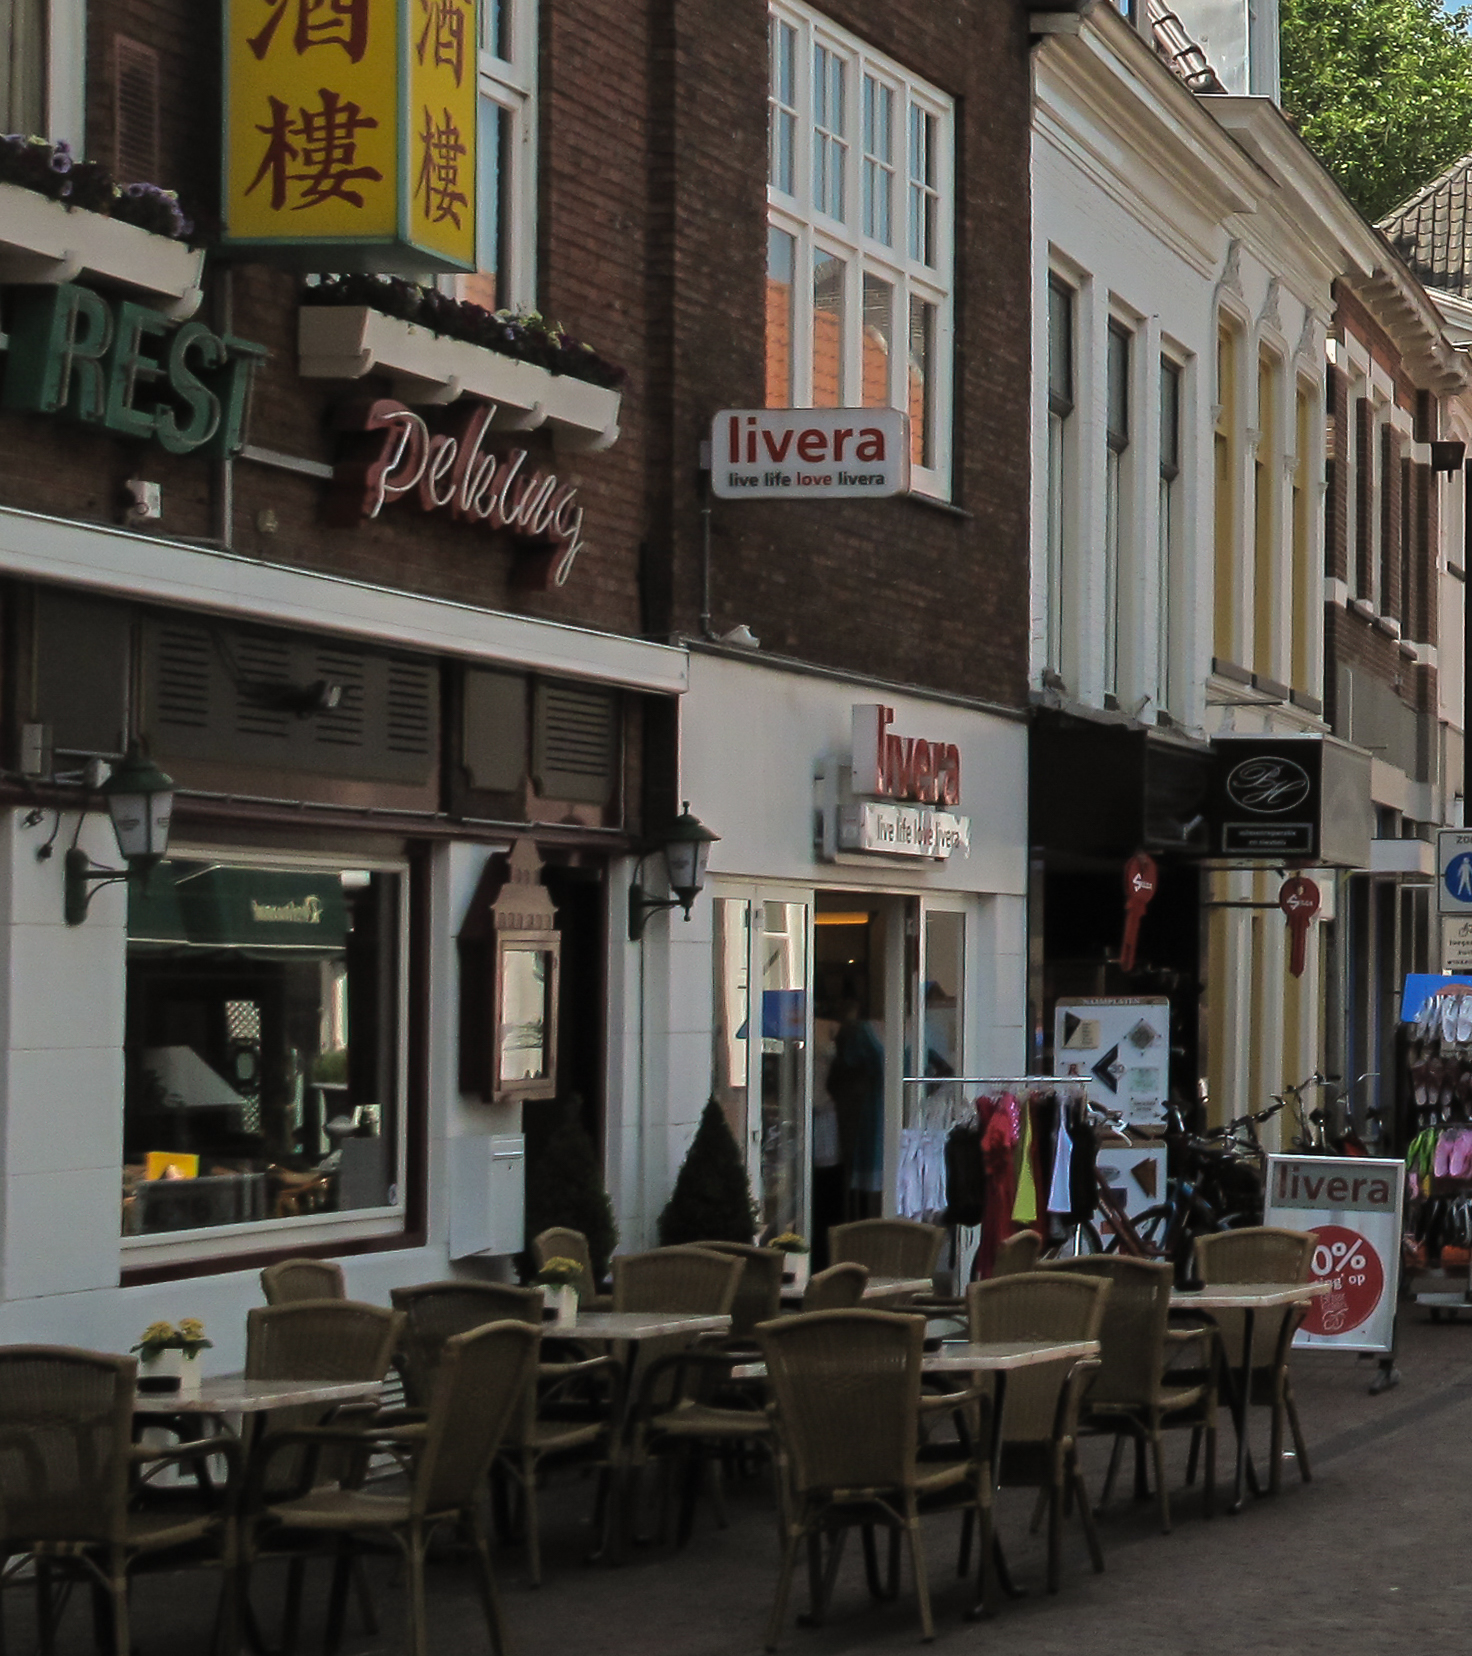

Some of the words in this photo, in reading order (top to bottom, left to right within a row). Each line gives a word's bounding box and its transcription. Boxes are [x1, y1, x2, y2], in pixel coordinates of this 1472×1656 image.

[40, 282, 274, 458] REST
[729, 416, 886, 463] livera
[363, 399, 585, 587] Peking
[729, 473, 758, 487] live
[764, 472, 791, 486] life
[797, 472, 832, 486] love
[839, 472, 885, 486] livera
[874, 704, 961, 805] livera
[1279, 1164, 1390, 1204] livera
[1311, 1238, 1363, 1276] 0%
[1348, 1274, 1365, 1286] op
